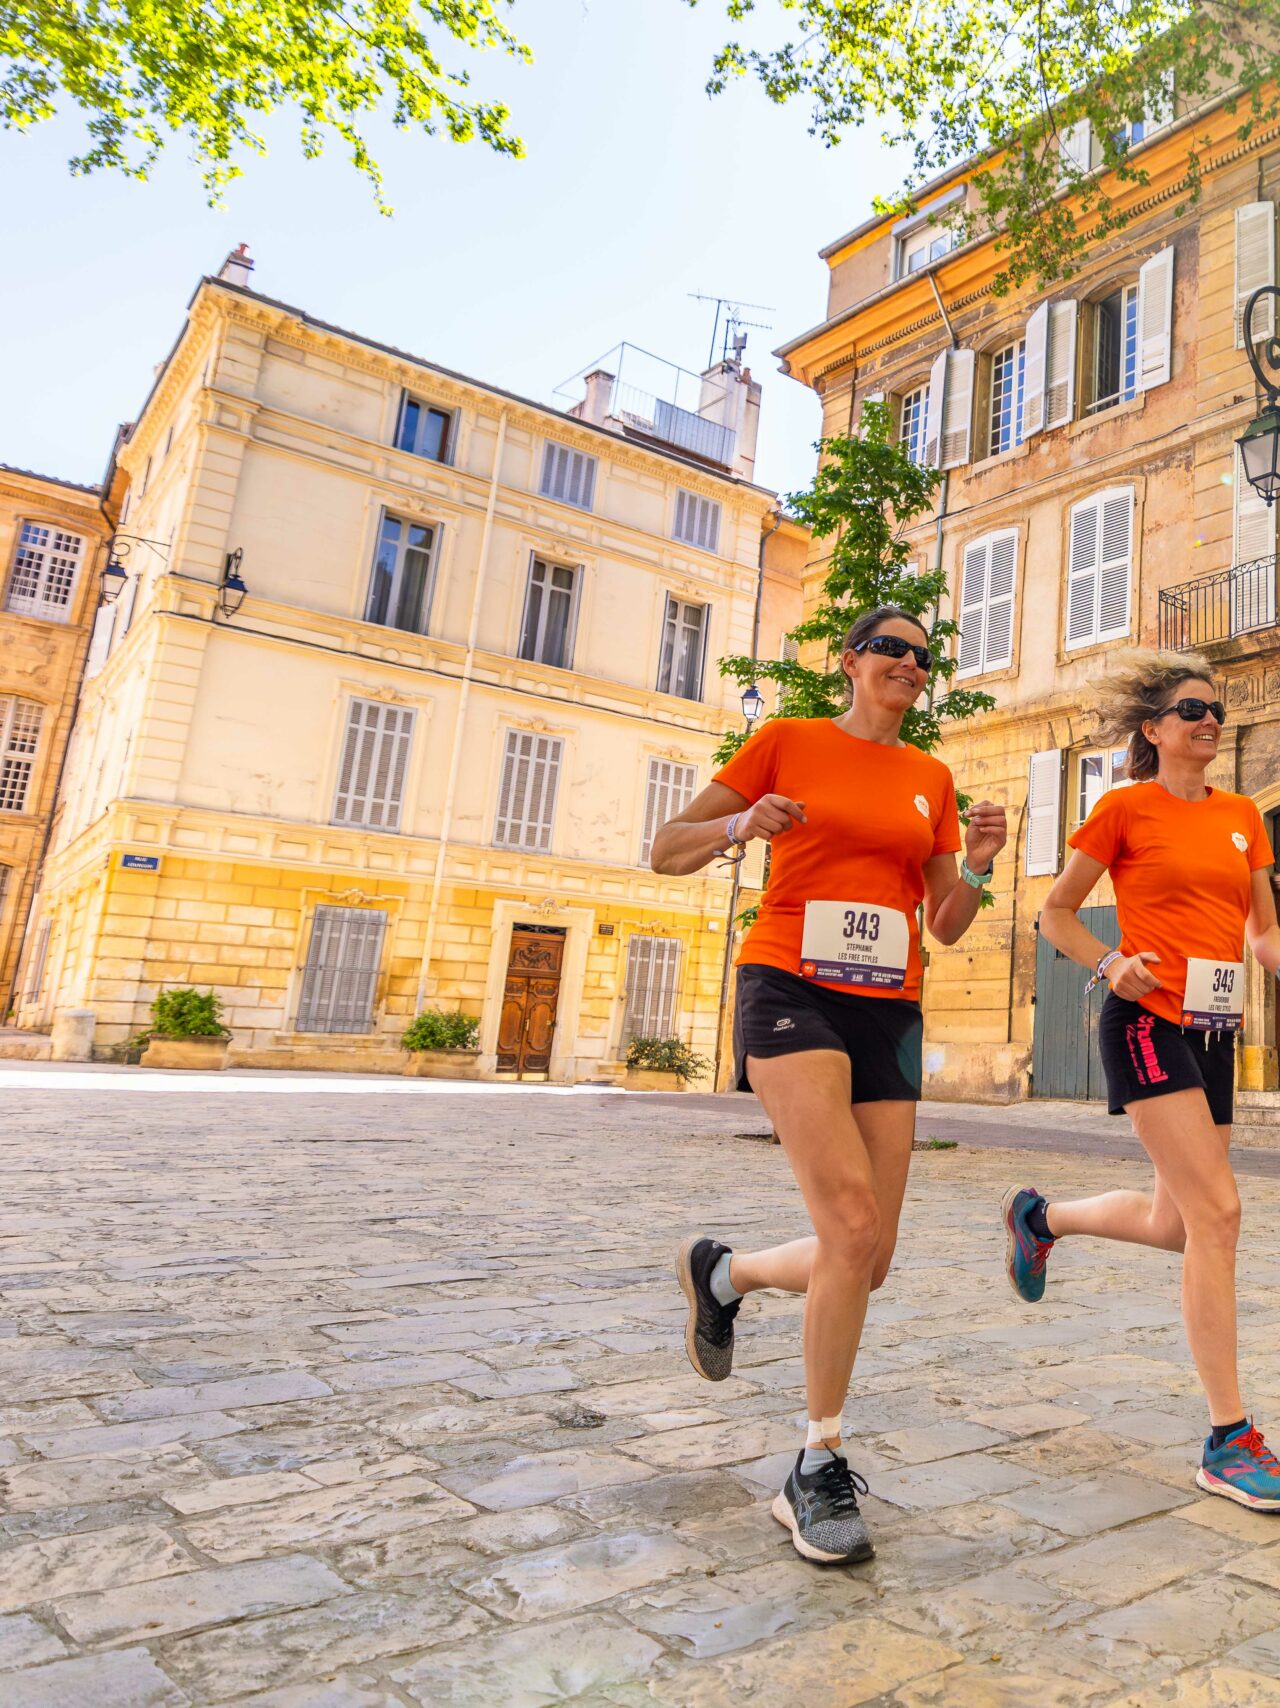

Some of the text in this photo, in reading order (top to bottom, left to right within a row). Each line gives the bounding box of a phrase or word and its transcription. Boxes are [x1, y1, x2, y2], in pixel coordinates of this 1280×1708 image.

[843, 910, 880, 941] 343
[838, 952, 878, 963] LES FREE STYLES
[846, 943, 873, 953] STEPHANIE
[1213, 968, 1235, 993] 343
[1137, 1023, 1168, 1083] hummel
